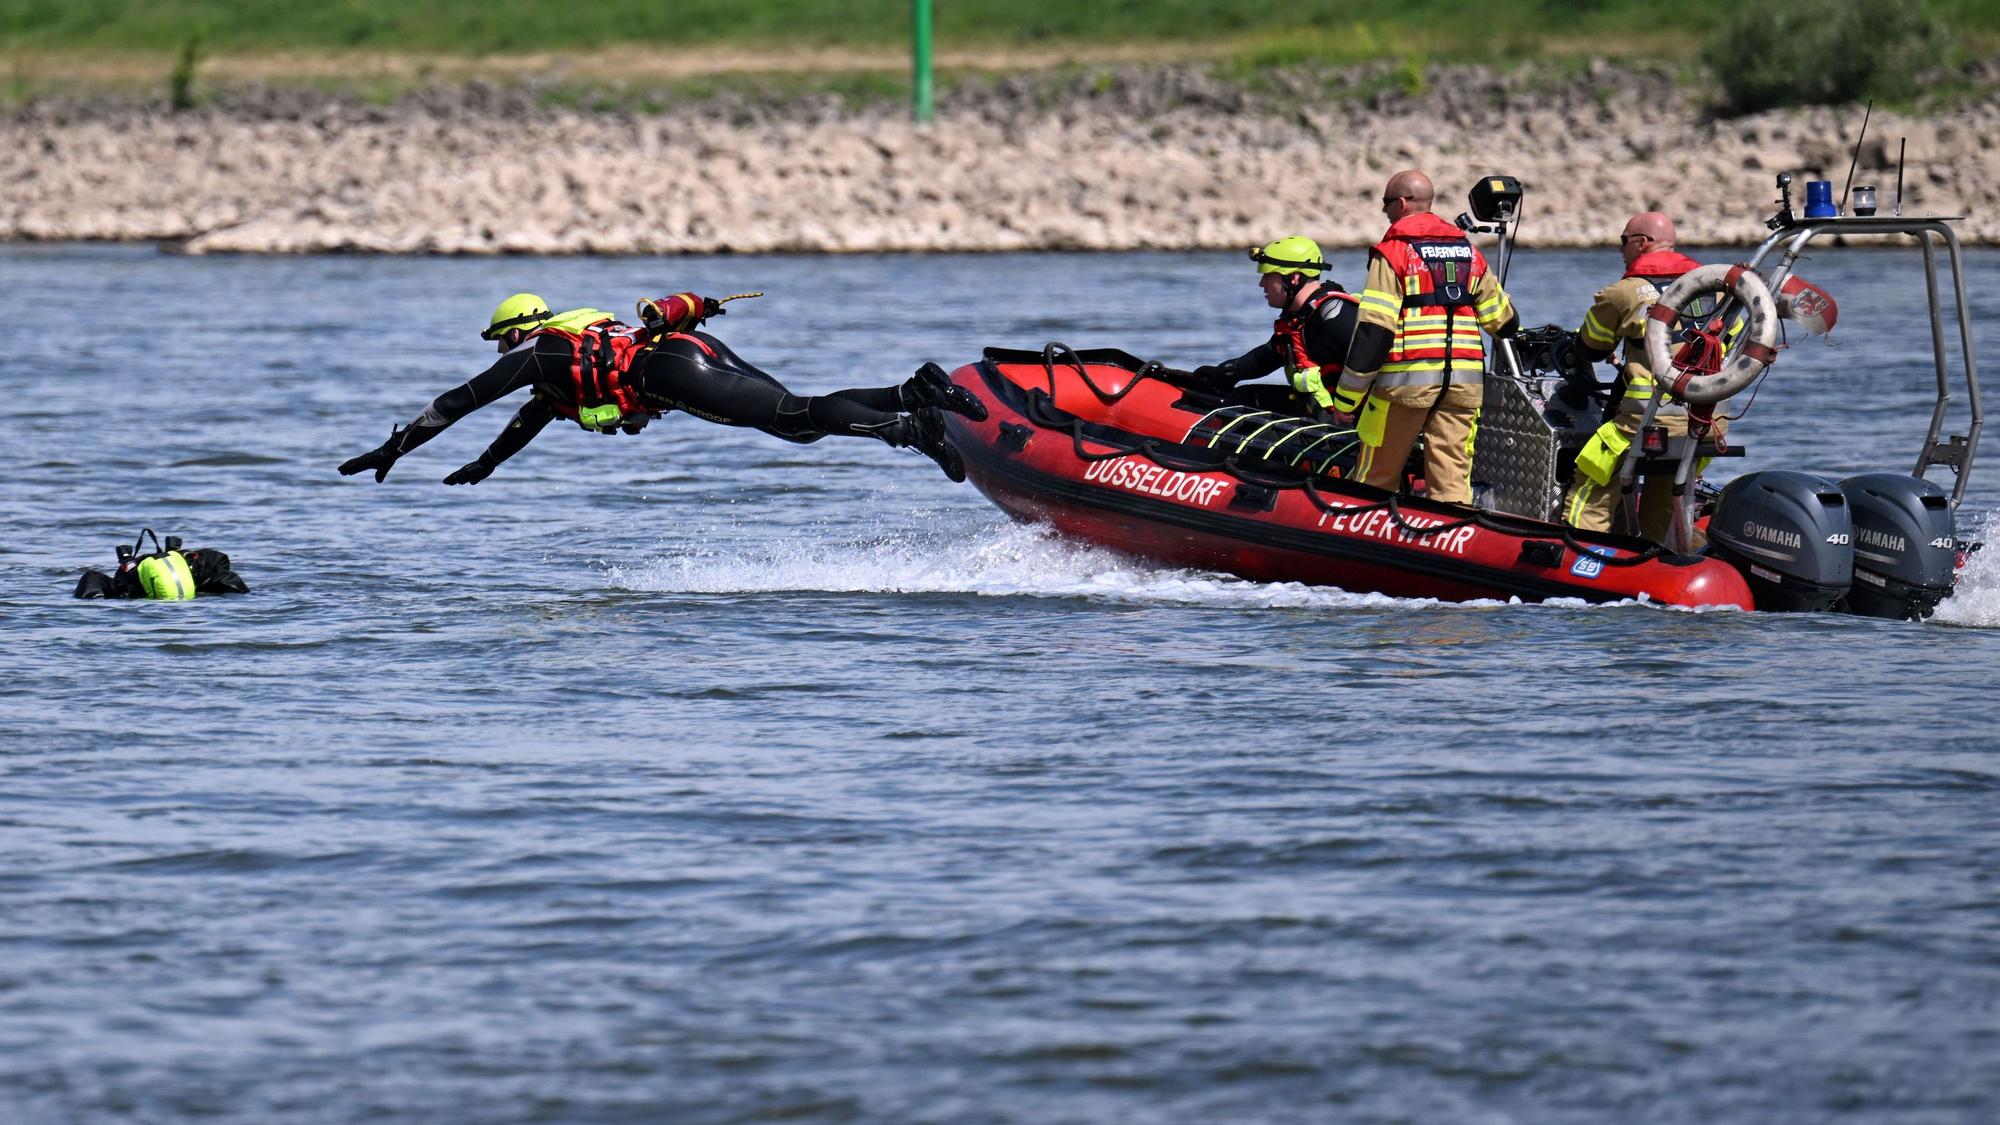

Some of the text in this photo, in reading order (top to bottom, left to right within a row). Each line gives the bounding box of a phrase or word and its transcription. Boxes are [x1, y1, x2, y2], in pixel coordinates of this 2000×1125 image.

[1421, 245, 1472, 258] FEUERWEHR
[1083, 455, 1229, 506] DÜSSELDORF
[1317, 501, 1475, 554] FEUERWEHR
[1755, 525, 1801, 549] YAMAHA
[1826, 533, 1849, 545] 40
[1860, 527, 1905, 552] YAMAHA
[1930, 537, 1953, 549] 40
